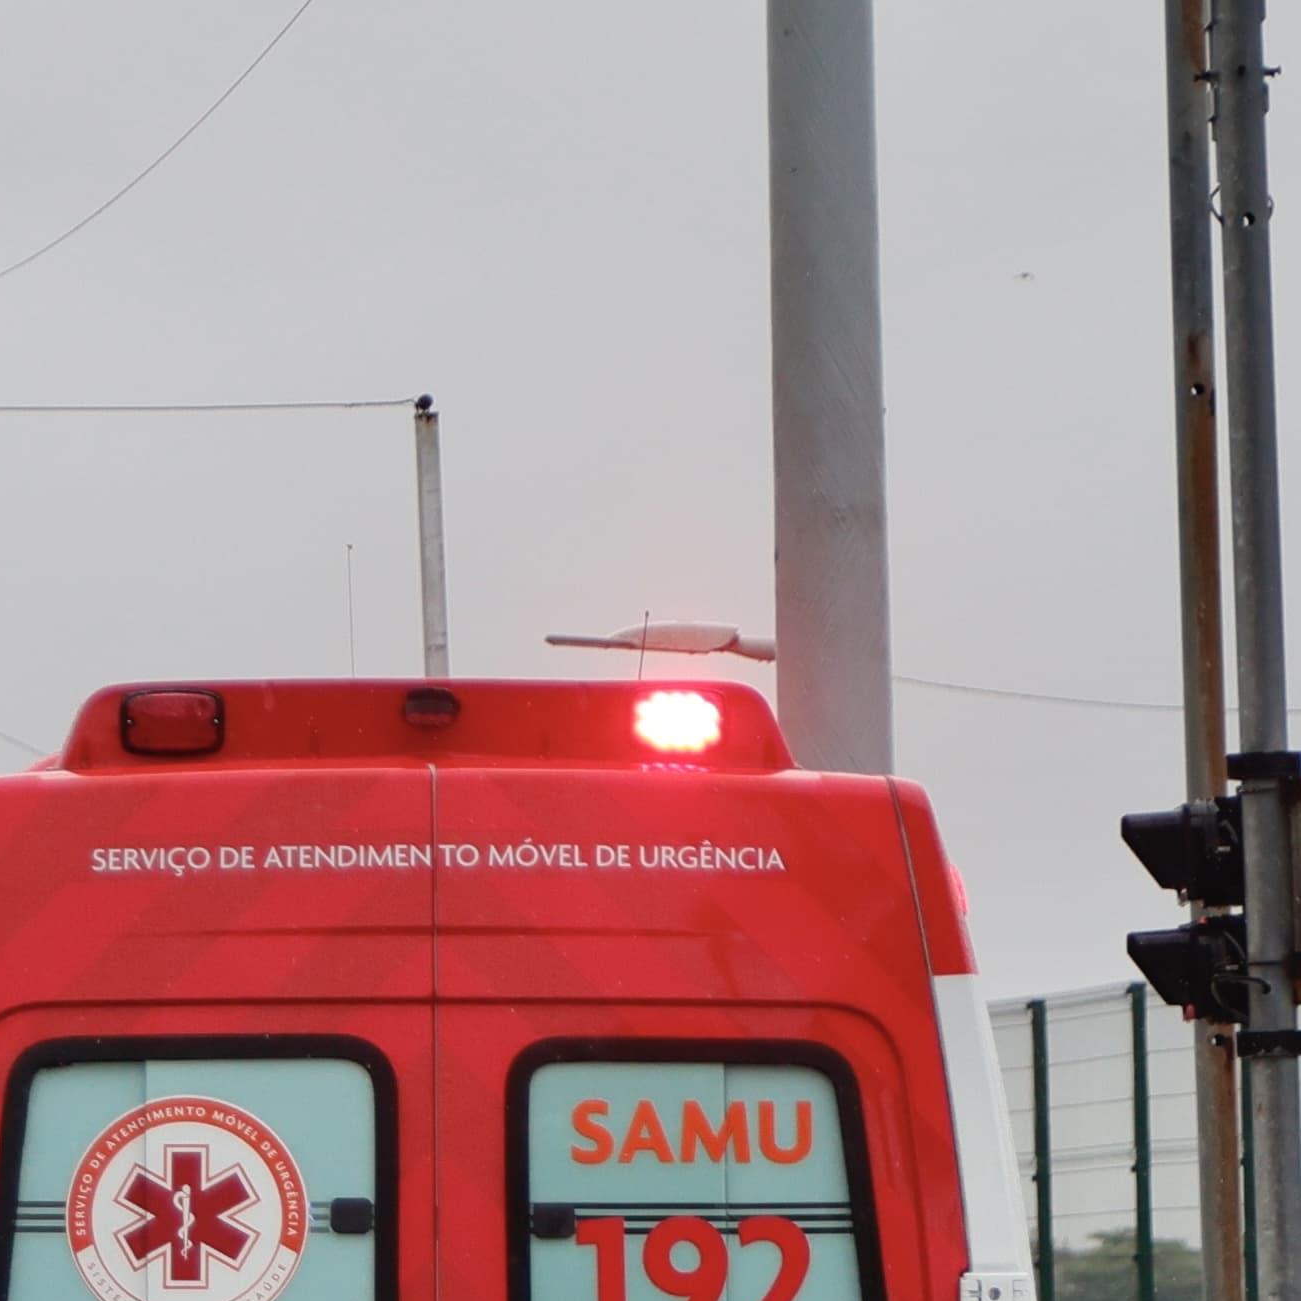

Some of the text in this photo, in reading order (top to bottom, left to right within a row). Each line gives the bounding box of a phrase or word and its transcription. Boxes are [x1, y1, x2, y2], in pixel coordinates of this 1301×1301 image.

[92, 846, 211, 876] SERVIÇO
[219, 845, 255, 870] DE
[488, 837, 588, 869] MÓVEL
[596, 843, 631, 868] DE
[639, 839, 786, 871] URGÊNCIA
[570, 1098, 813, 1165] SAMU
[75, 1105, 300, 1237] SERVIÇO DE ATENDIMENTO MÓVEL DE URGÊNCIA
